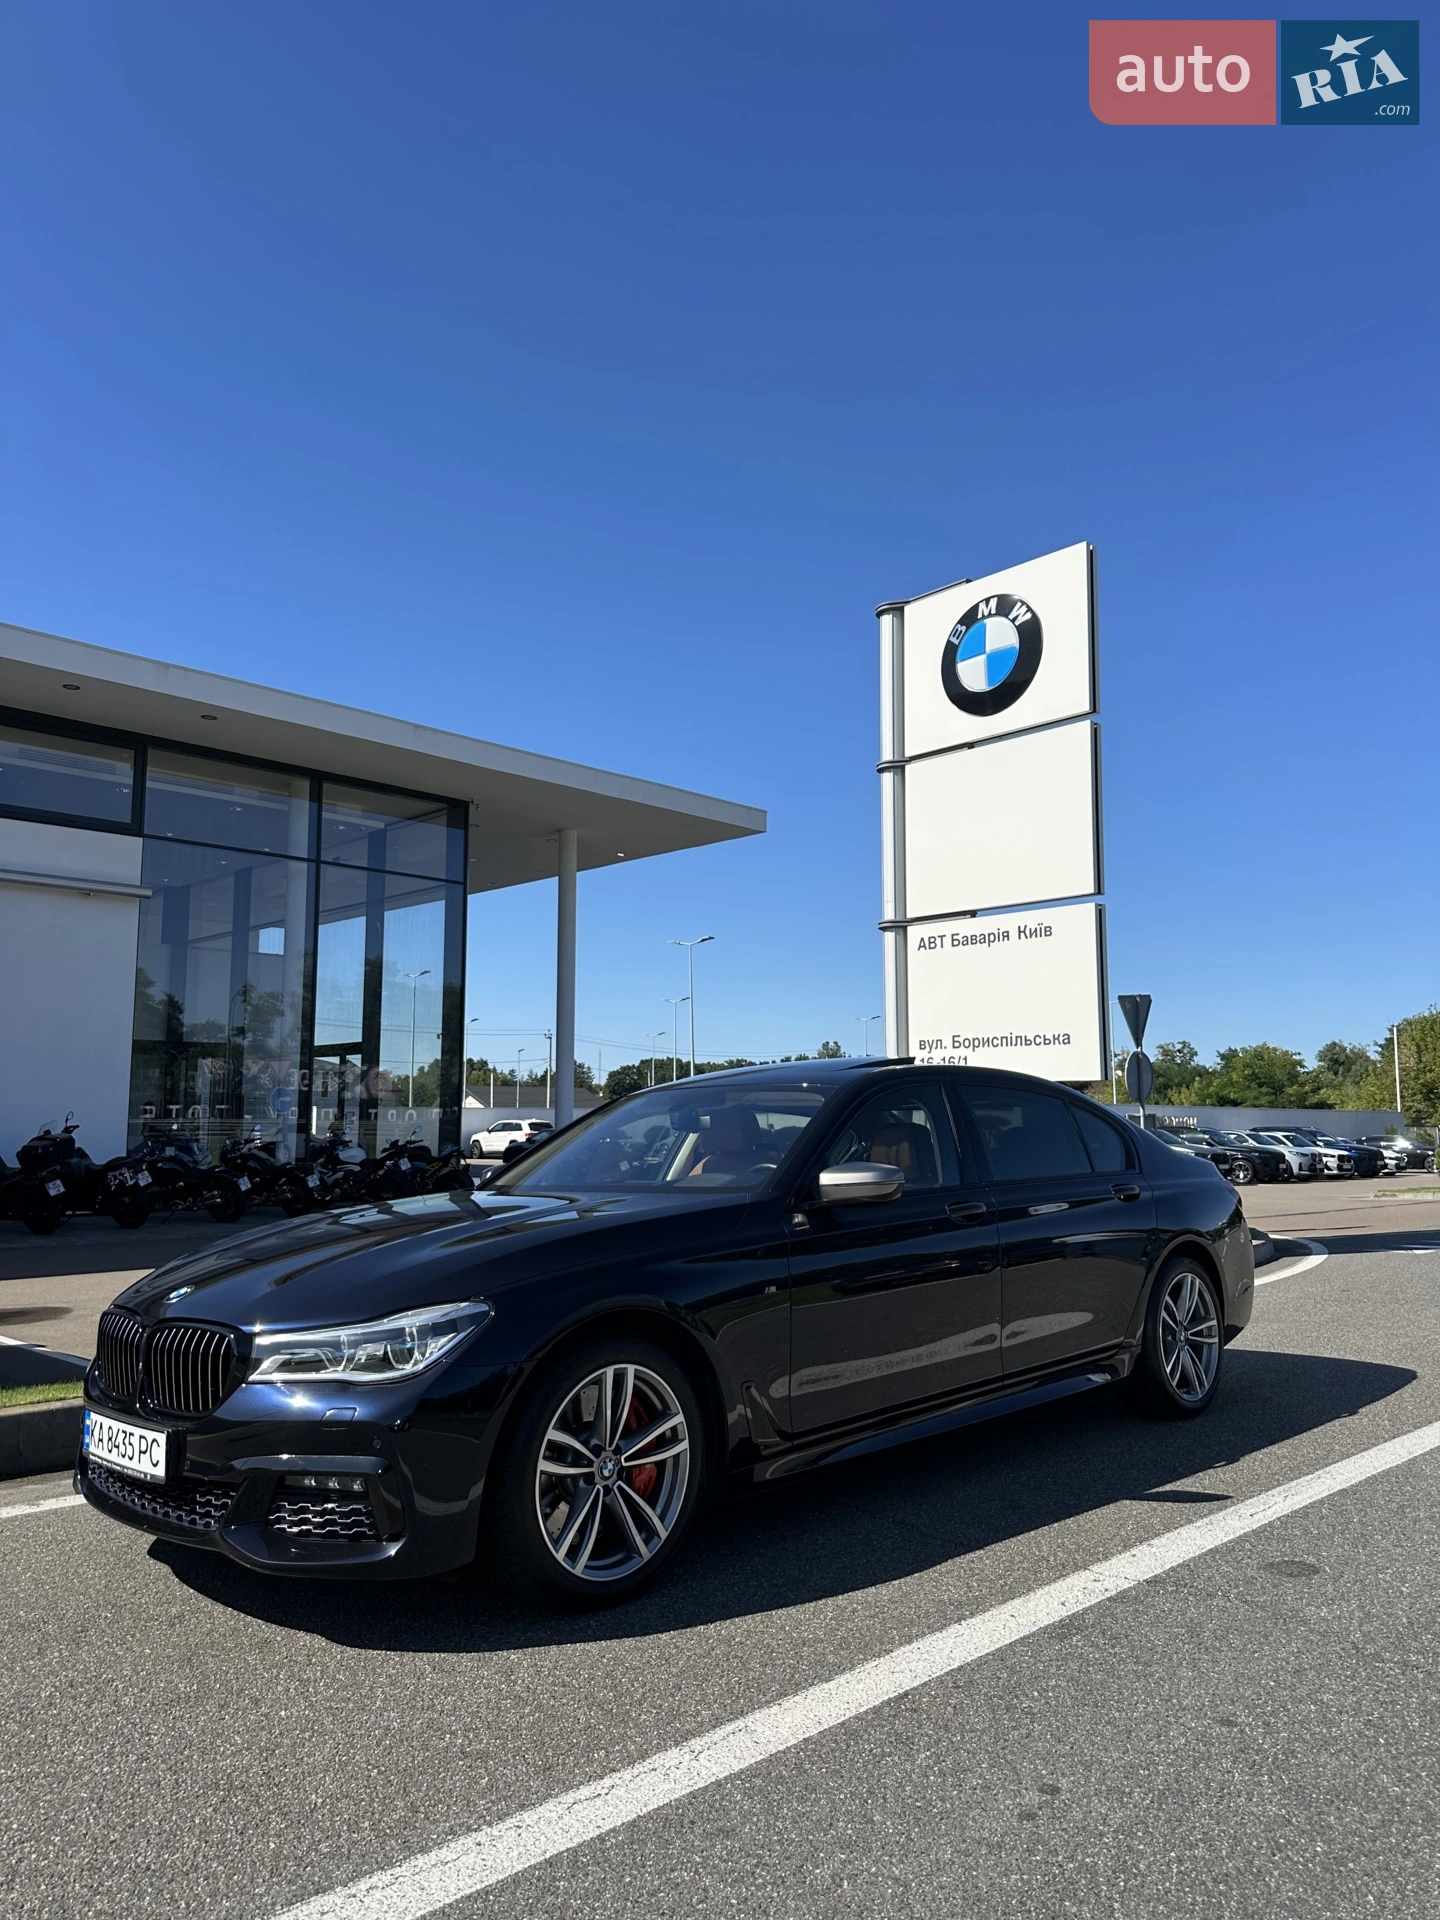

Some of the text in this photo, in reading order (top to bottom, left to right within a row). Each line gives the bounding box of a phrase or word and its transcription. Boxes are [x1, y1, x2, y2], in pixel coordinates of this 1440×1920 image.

[949, 597, 1033, 645] BMW
[917, 923, 1053, 951] АВТ Баварія Київ
[919, 1032, 1071, 1053] вул. Бориспільська
[90, 1418, 104, 1451] KA
[107, 1425, 135, 1461] 8435
[138, 1434, 161, 1468] PC
